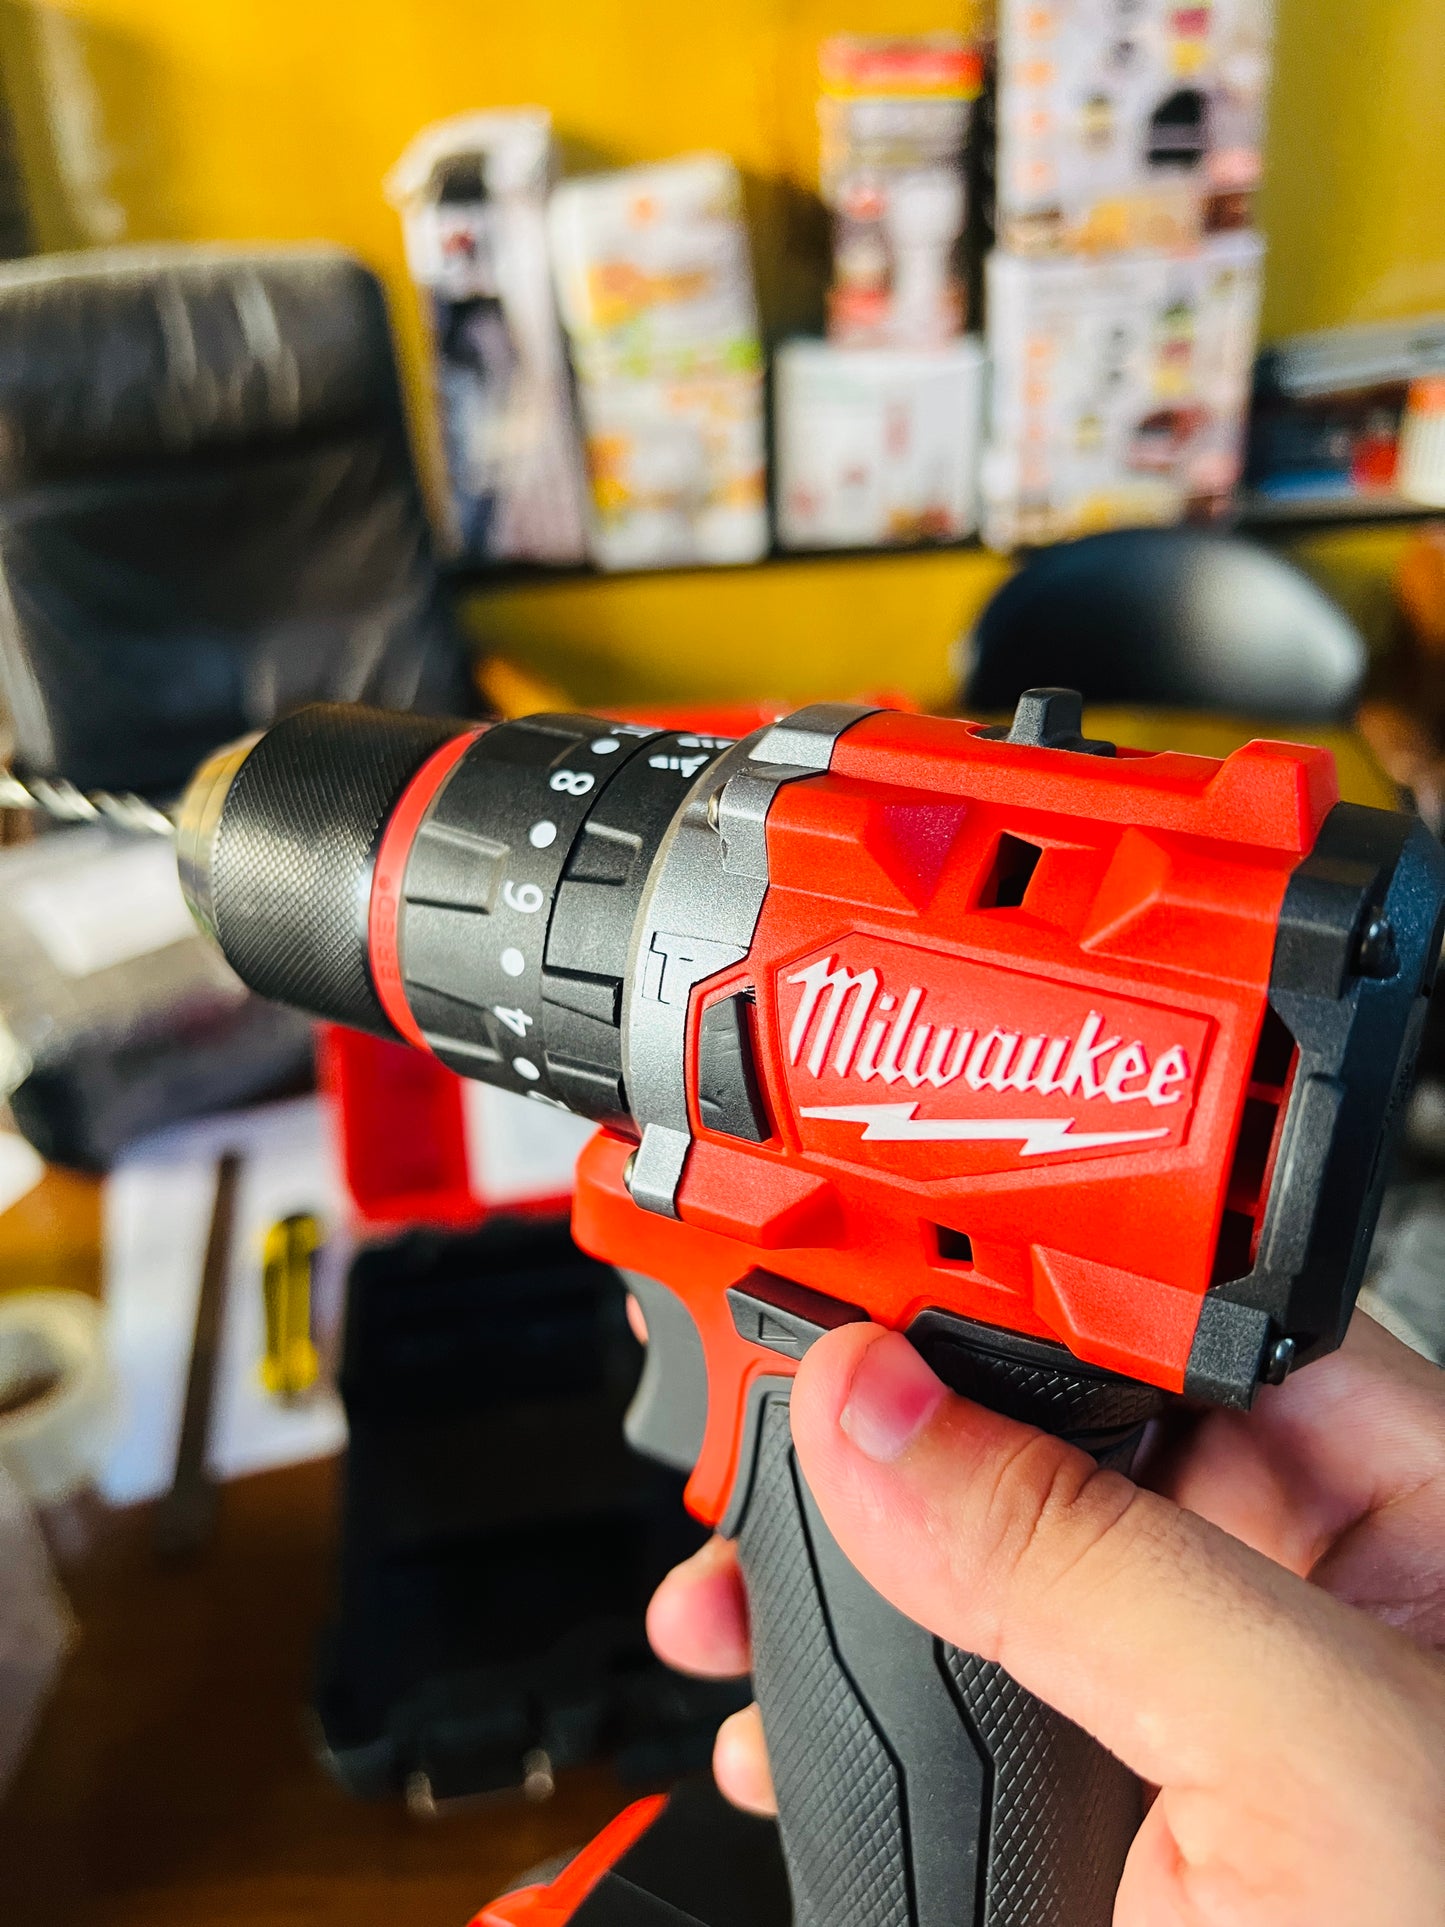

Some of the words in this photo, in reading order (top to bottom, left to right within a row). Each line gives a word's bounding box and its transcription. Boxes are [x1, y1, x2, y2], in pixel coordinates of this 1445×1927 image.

[549, 769, 596, 797] 8
[503, 879, 545, 914] 6
[492, 1004, 534, 1038] 4
[787, 953, 1189, 1107] Milwaukee
